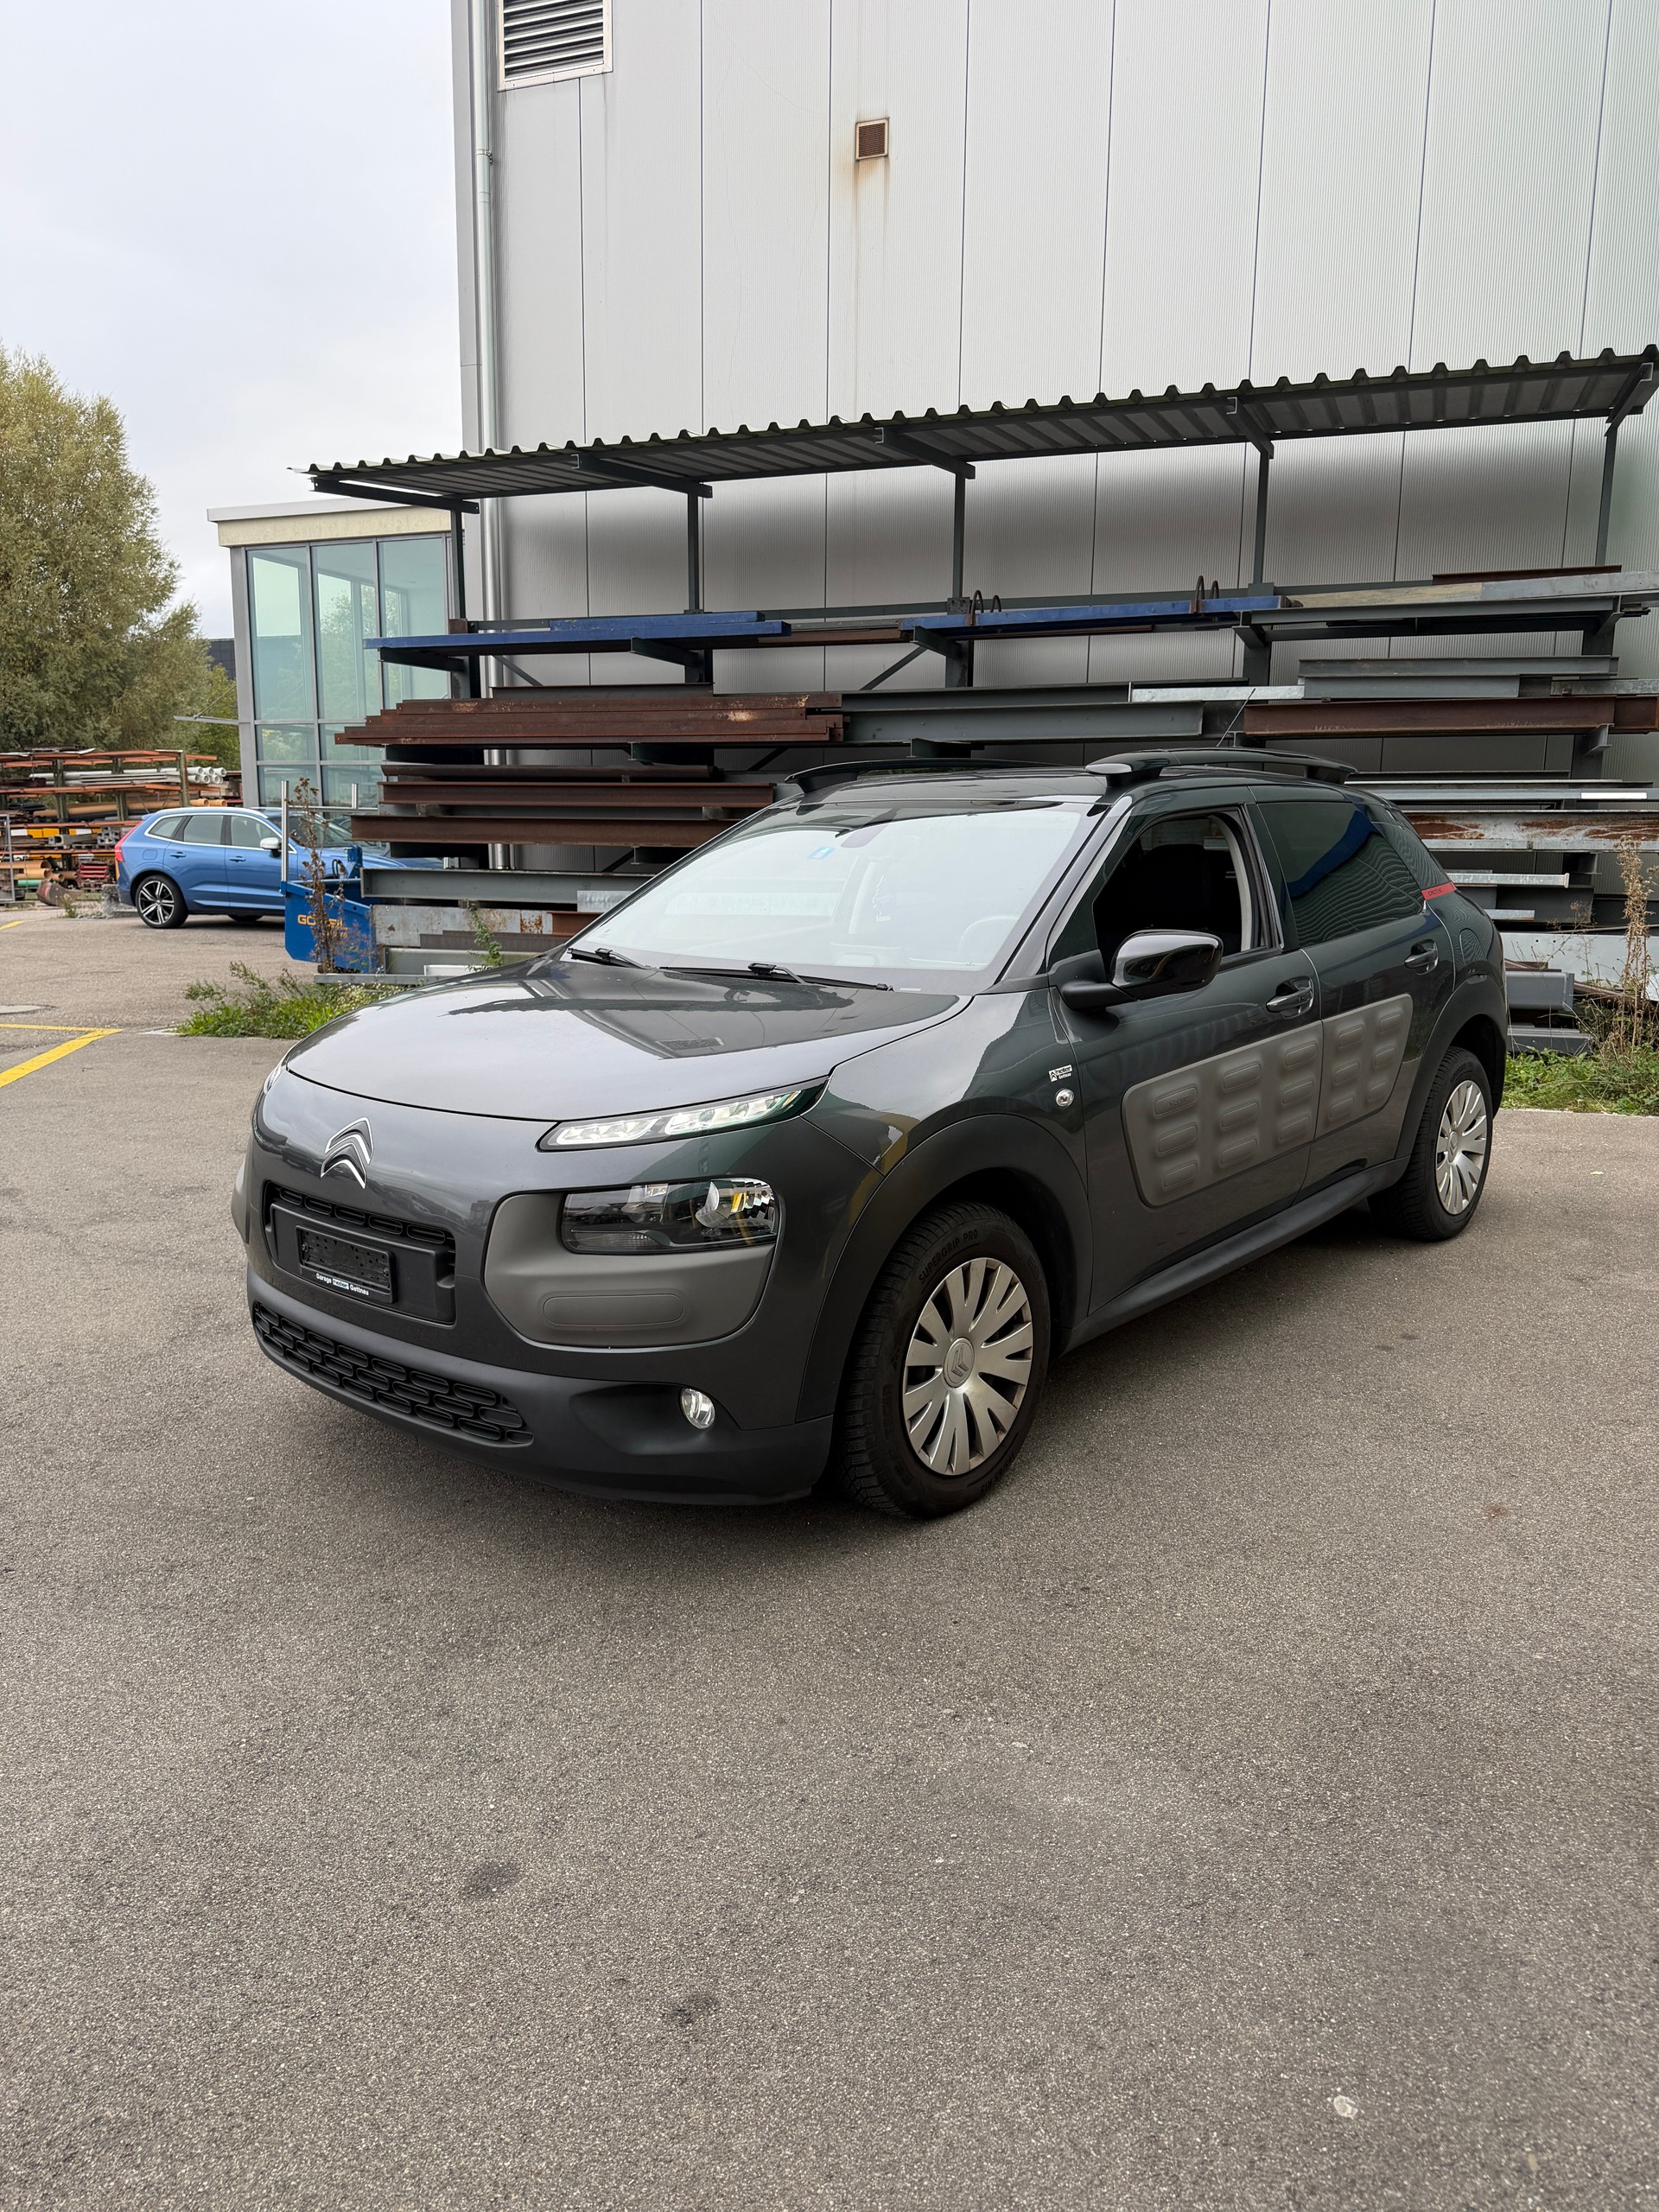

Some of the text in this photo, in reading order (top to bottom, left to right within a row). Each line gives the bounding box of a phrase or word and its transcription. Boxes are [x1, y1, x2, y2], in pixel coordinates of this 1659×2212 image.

[918, 1229, 978, 1285] SUPERGRIP PRO
[315, 1273, 332, 1284] Garage
